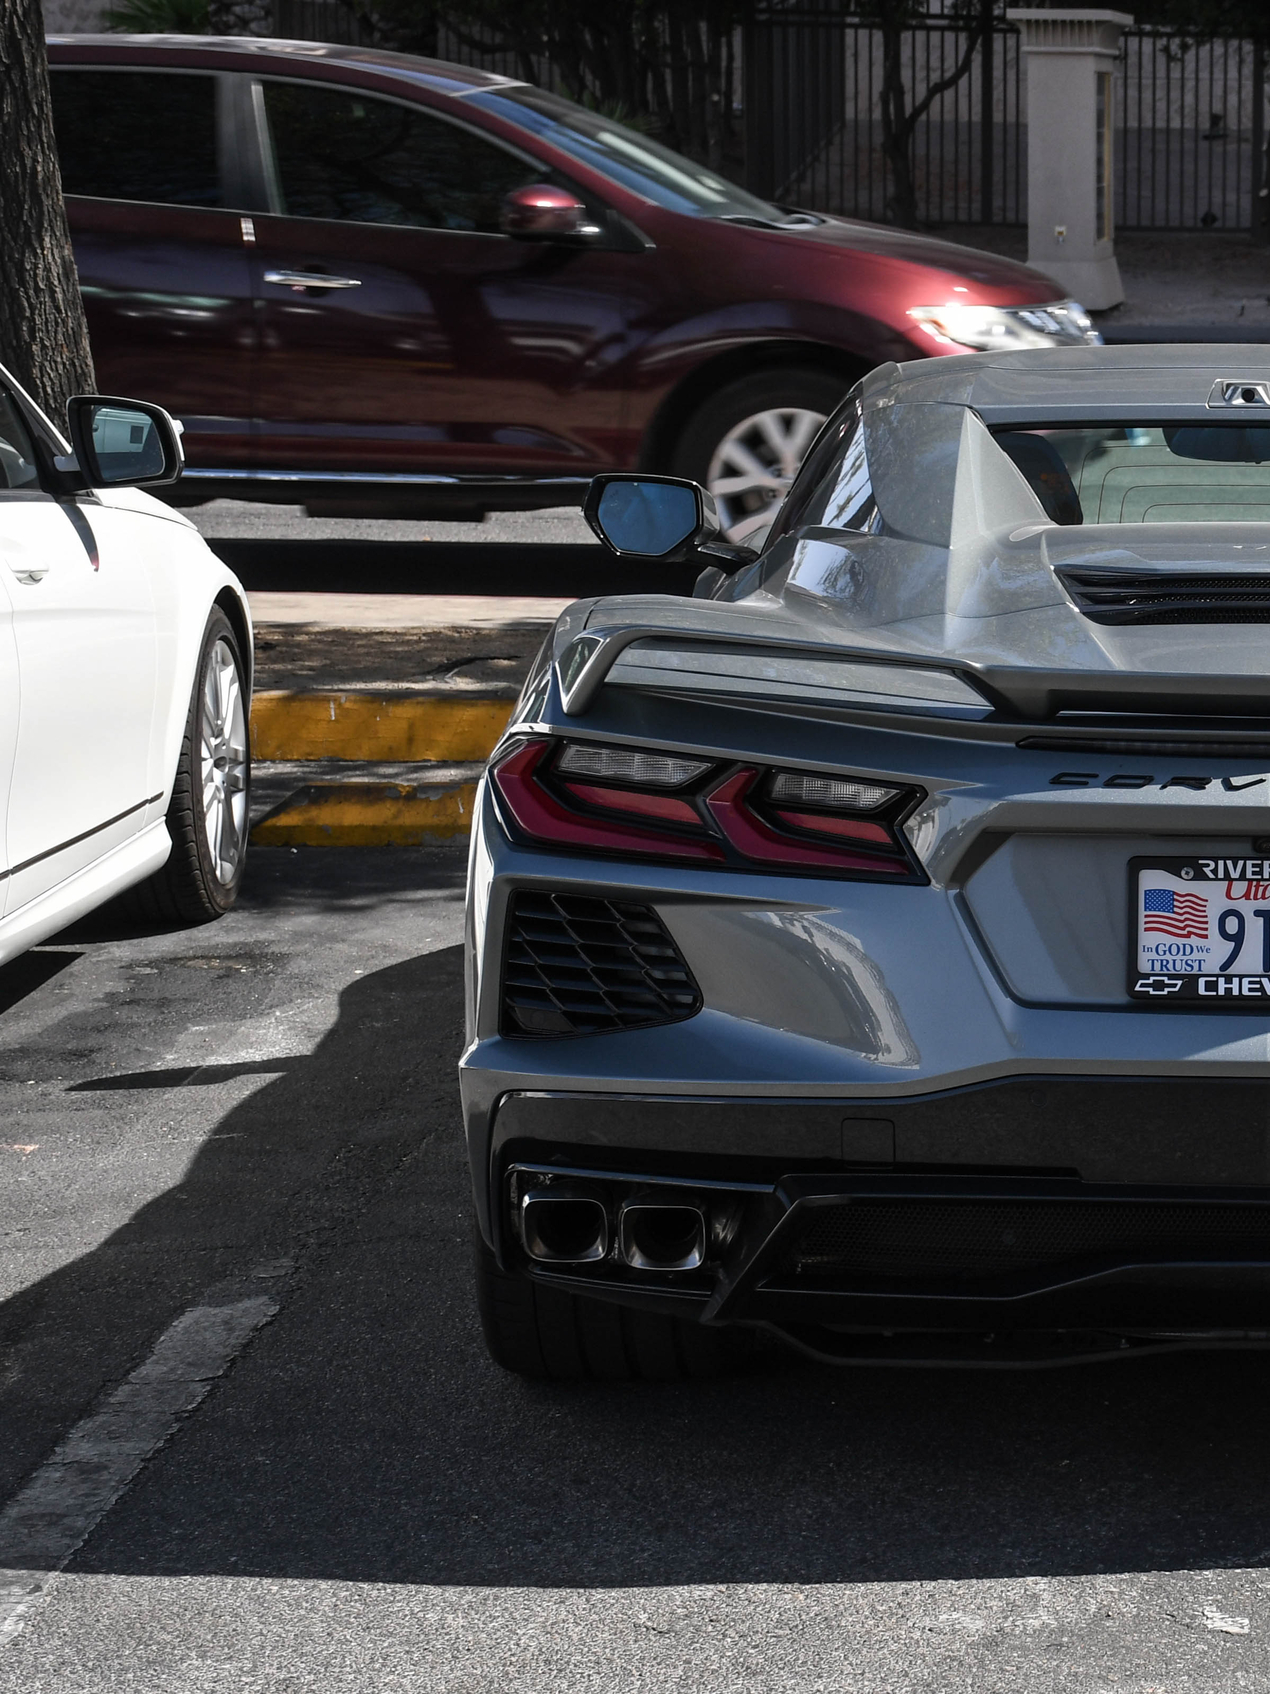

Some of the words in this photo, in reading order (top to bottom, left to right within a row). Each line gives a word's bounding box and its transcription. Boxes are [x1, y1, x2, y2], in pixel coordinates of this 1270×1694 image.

[1142, 945, 1153, 953] In
[1155, 942, 1194, 957] GOD
[1196, 945, 1211, 954] We
[1147, 958, 1206, 972] TRUST
